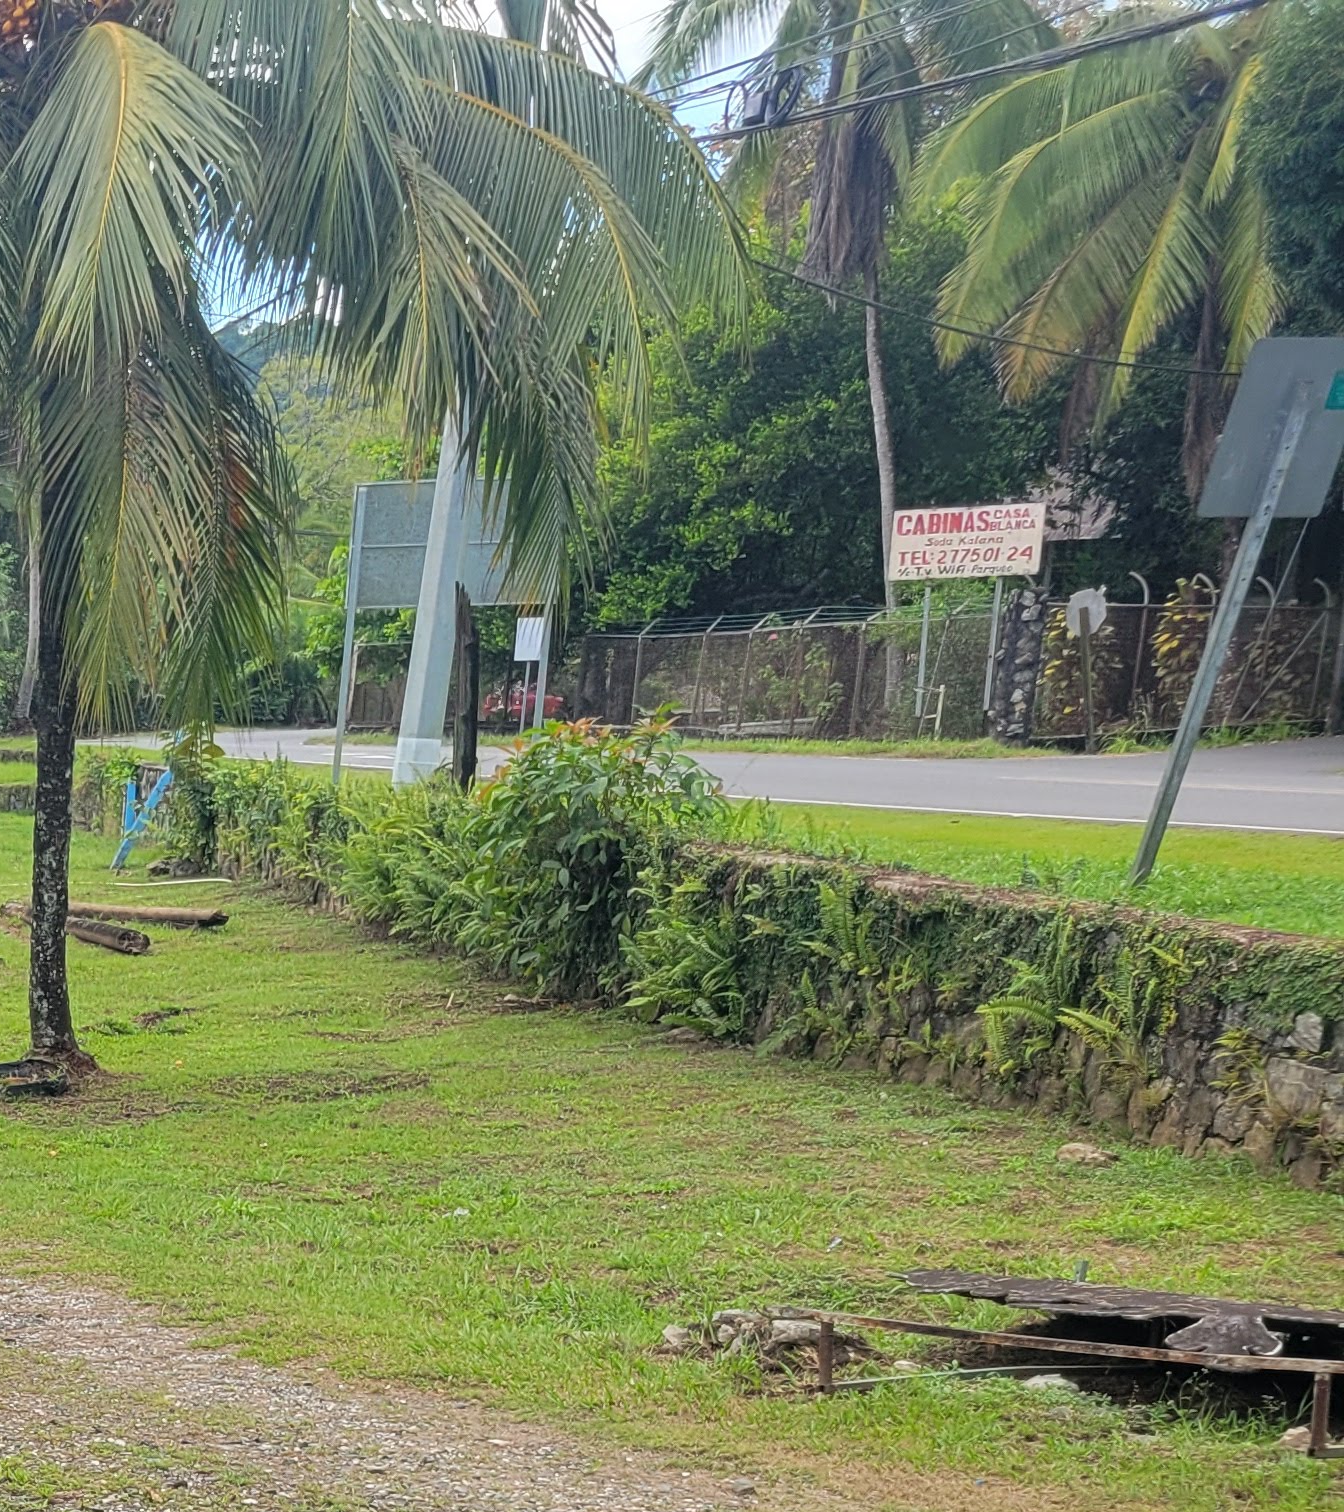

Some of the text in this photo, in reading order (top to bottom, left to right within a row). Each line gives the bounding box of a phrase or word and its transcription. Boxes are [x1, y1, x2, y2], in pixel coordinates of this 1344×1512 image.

[993, 508, 1030, 519] CASA
[896, 511, 990, 536] CABINAS
[989, 519, 1036, 531] BLANCA
[924, 537, 953, 547] Soda
[898, 550, 934, 566] TEL:
